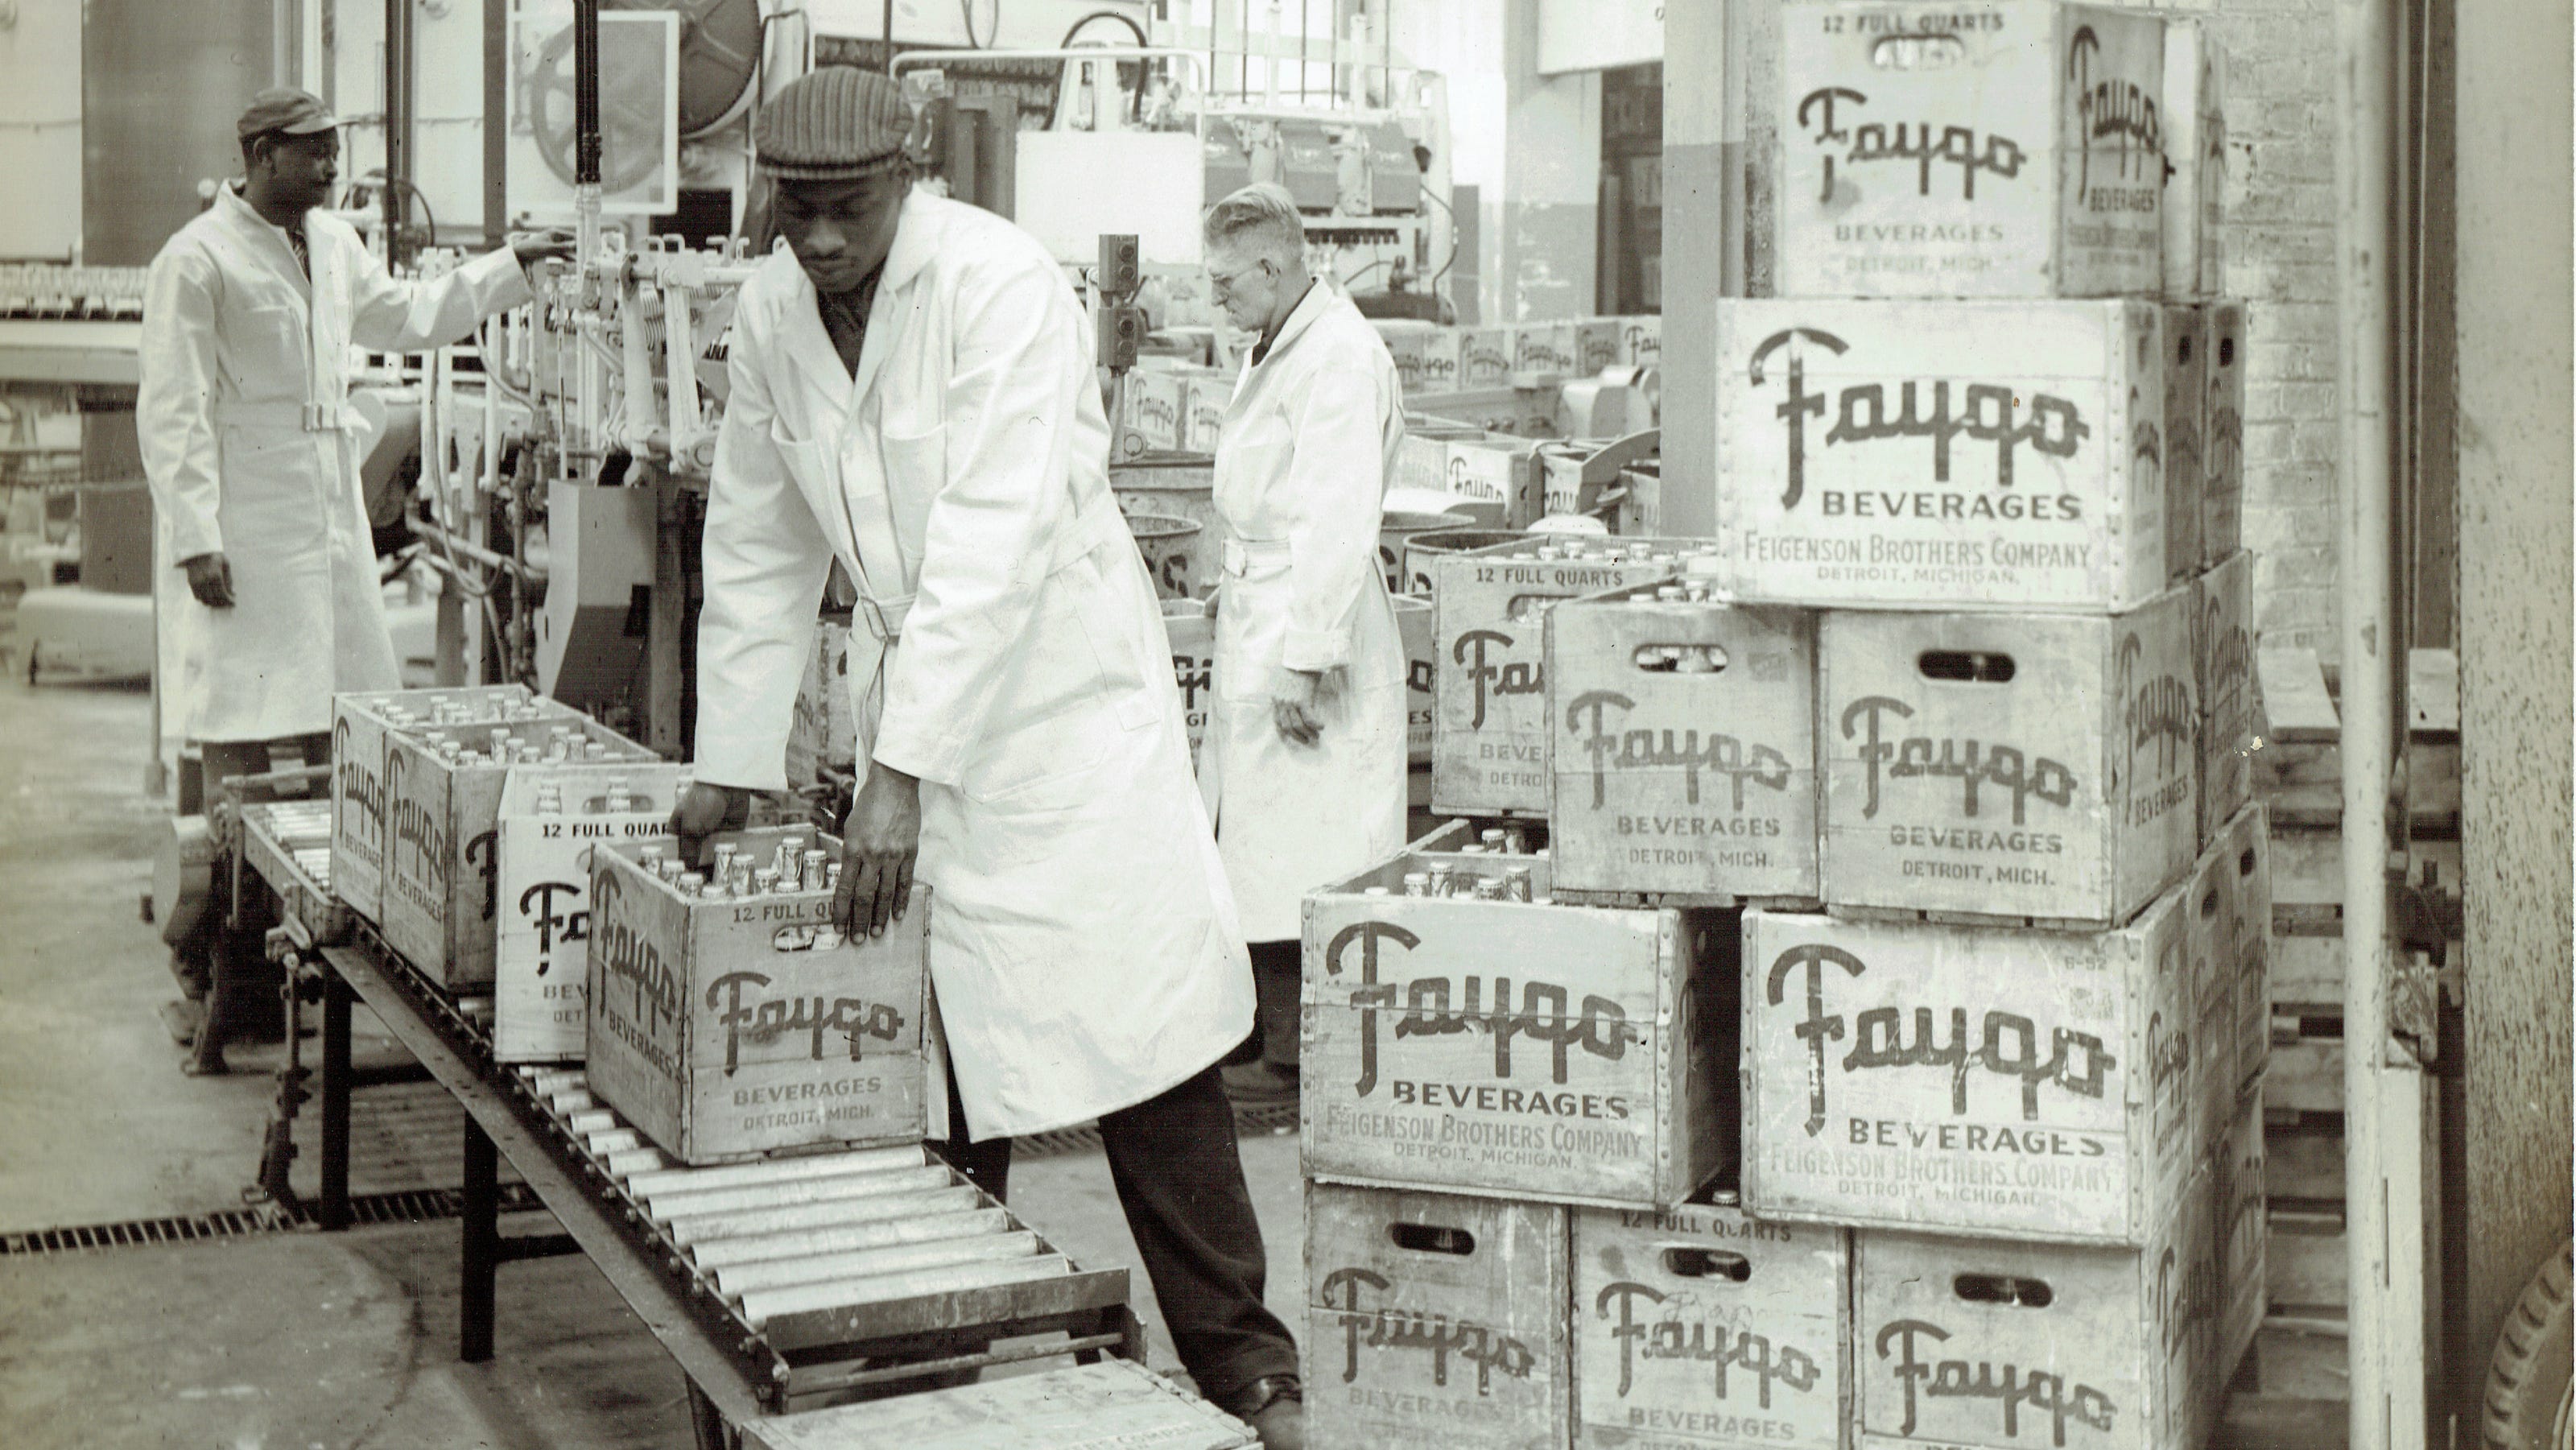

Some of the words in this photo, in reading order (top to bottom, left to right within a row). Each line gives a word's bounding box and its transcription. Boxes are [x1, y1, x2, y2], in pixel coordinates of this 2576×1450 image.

[1823, 15, 1844, 33] 12
[1856, 14, 1906, 35] FULL
[1918, 13, 2004, 33] QUARTS
[1798, 86, 2027, 204] Faygo
[1835, 223, 2004, 242] BEVERAGES
[1749, 327, 2091, 511] Faygo
[1822, 490, 2083, 521] BEVERAGES
[1744, 529, 1861, 564] FEIGENSON
[1869, 534, 1984, 565] BROTHERS
[1991, 537, 2092, 569] COMPANY
[1476, 568, 1494, 583] 12
[1505, 568, 1545, 584] FULL
[1555, 569, 1624, 587] QUARTS
[1817, 565, 1906, 583] DETROIT,
[1480, 743, 1542, 762] BEVE
[1566, 690, 1793, 811] Faygo
[1841, 696, 2079, 826] Faygo
[1490, 770, 1542, 788] DETRO
[543, 823, 562, 838] 12
[572, 822, 615, 838] FULL
[1617, 816, 1781, 838] BEVERAGES
[1890, 824, 2064, 855] BEVERAGES
[1902, 859, 1992, 885] DETROIT,
[1996, 865, 2057, 887] MICH.
[733, 907, 755, 923] 12
[763, 903, 805, 922] FULL
[595, 868, 676, 1038] Faygo
[705, 970, 905, 1077] Faygo
[1325, 919, 1649, 1098] Faygo
[609, 1009, 675, 1080] BEVERAGES
[1766, 943, 2116, 1138] Faygo
[733, 1076, 881, 1106] BEVERAGES
[1393, 1080, 1629, 1121] BEVERAGES
[744, 1109, 821, 1131] DETROIT,
[1441, 1113, 1545, 1150] BROTHERS
[1550, 1122, 1642, 1160] COMPANY
[1849, 1117, 2106, 1158] BEVERAGES
[1480, 1150, 1578, 1170] MICHIGAN.
[1838, 1179, 1924, 1201] DETROIT,
[1621, 1211, 1642, 1229] 12
[1653, 1213, 1703, 1235] FULL
[1322, 1267, 1537, 1397] Faygo
[1596, 1282, 1822, 1411] Faygo
[1875, 1318, 2118, 1448] Faygo
[1628, 1407, 1797, 1441] BEVERAGES
